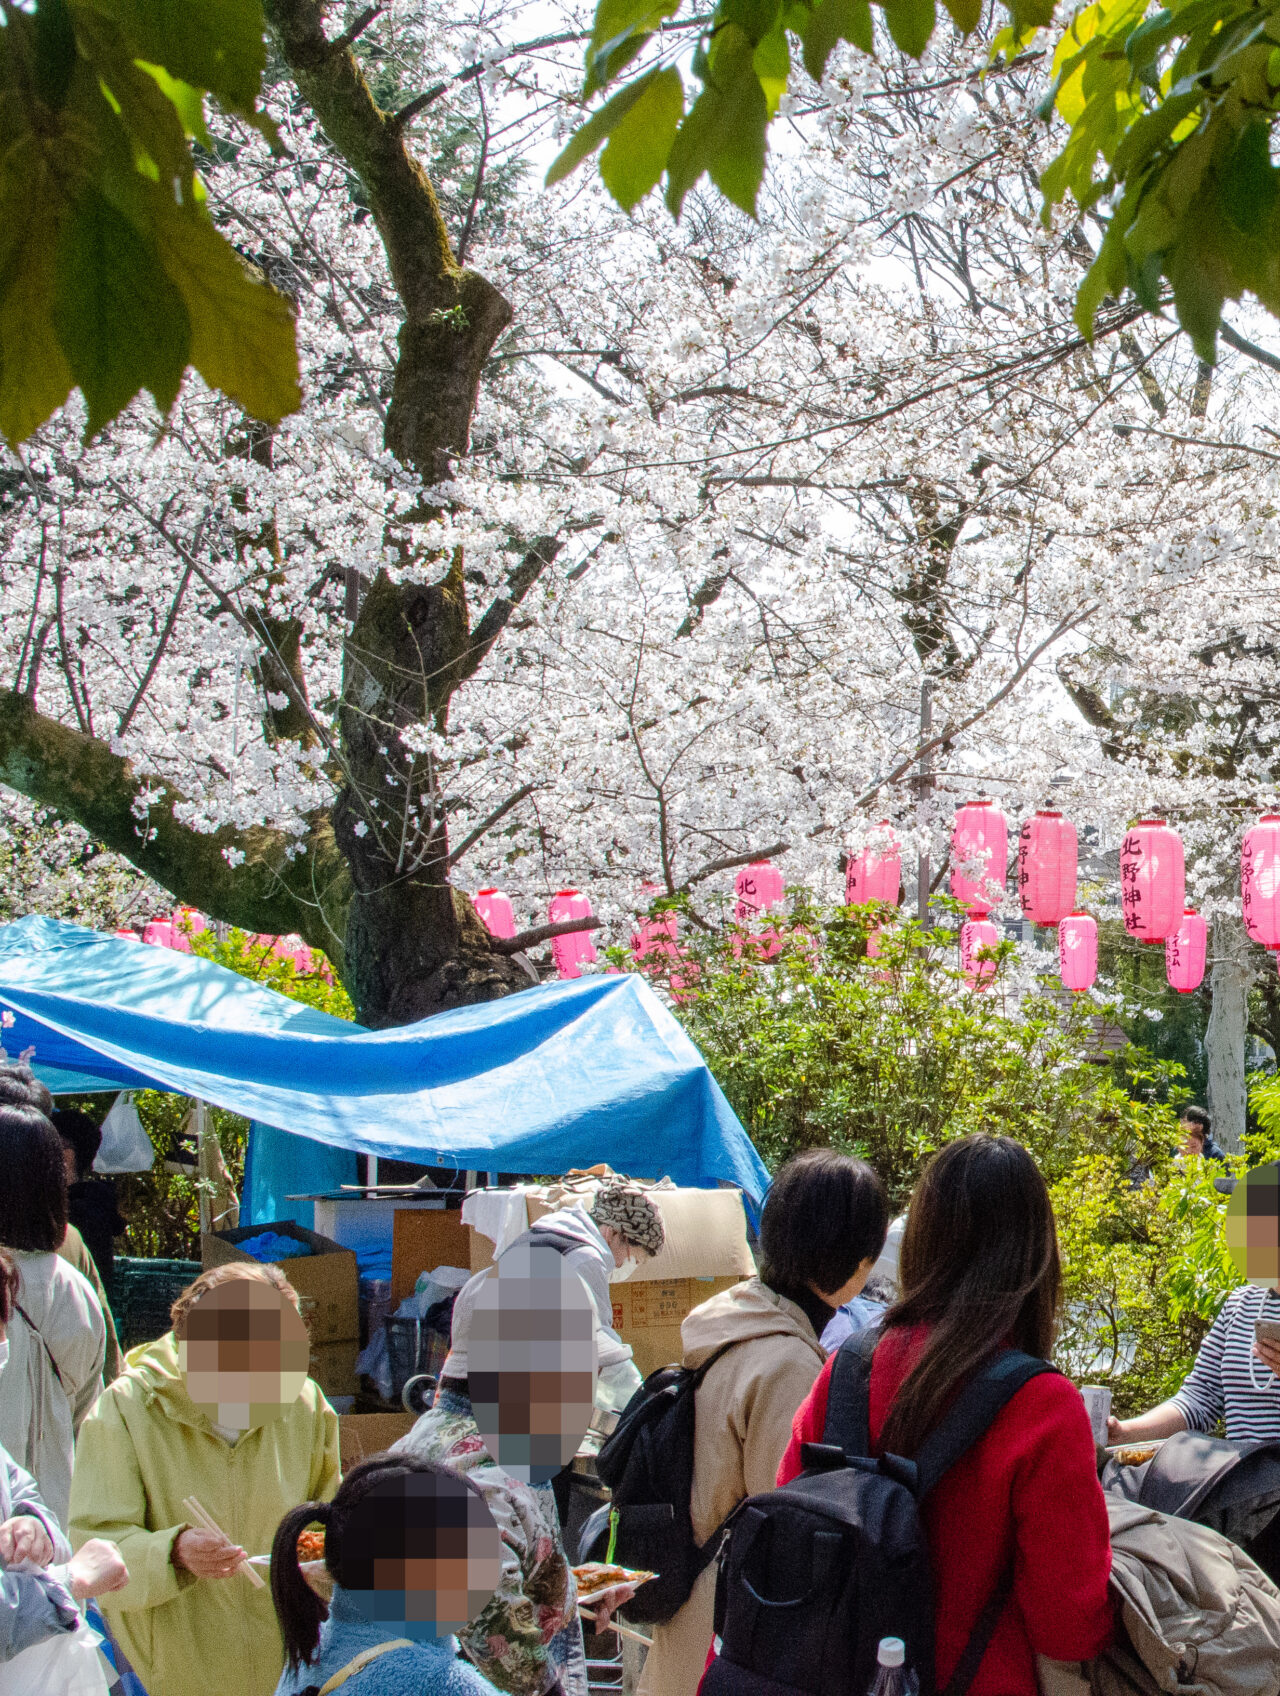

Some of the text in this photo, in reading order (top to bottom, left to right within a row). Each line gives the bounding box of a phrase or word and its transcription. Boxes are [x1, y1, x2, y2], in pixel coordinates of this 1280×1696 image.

[1121, 836, 1147, 930] 北野神社
[965, 925, 975, 972] ジェイコム
